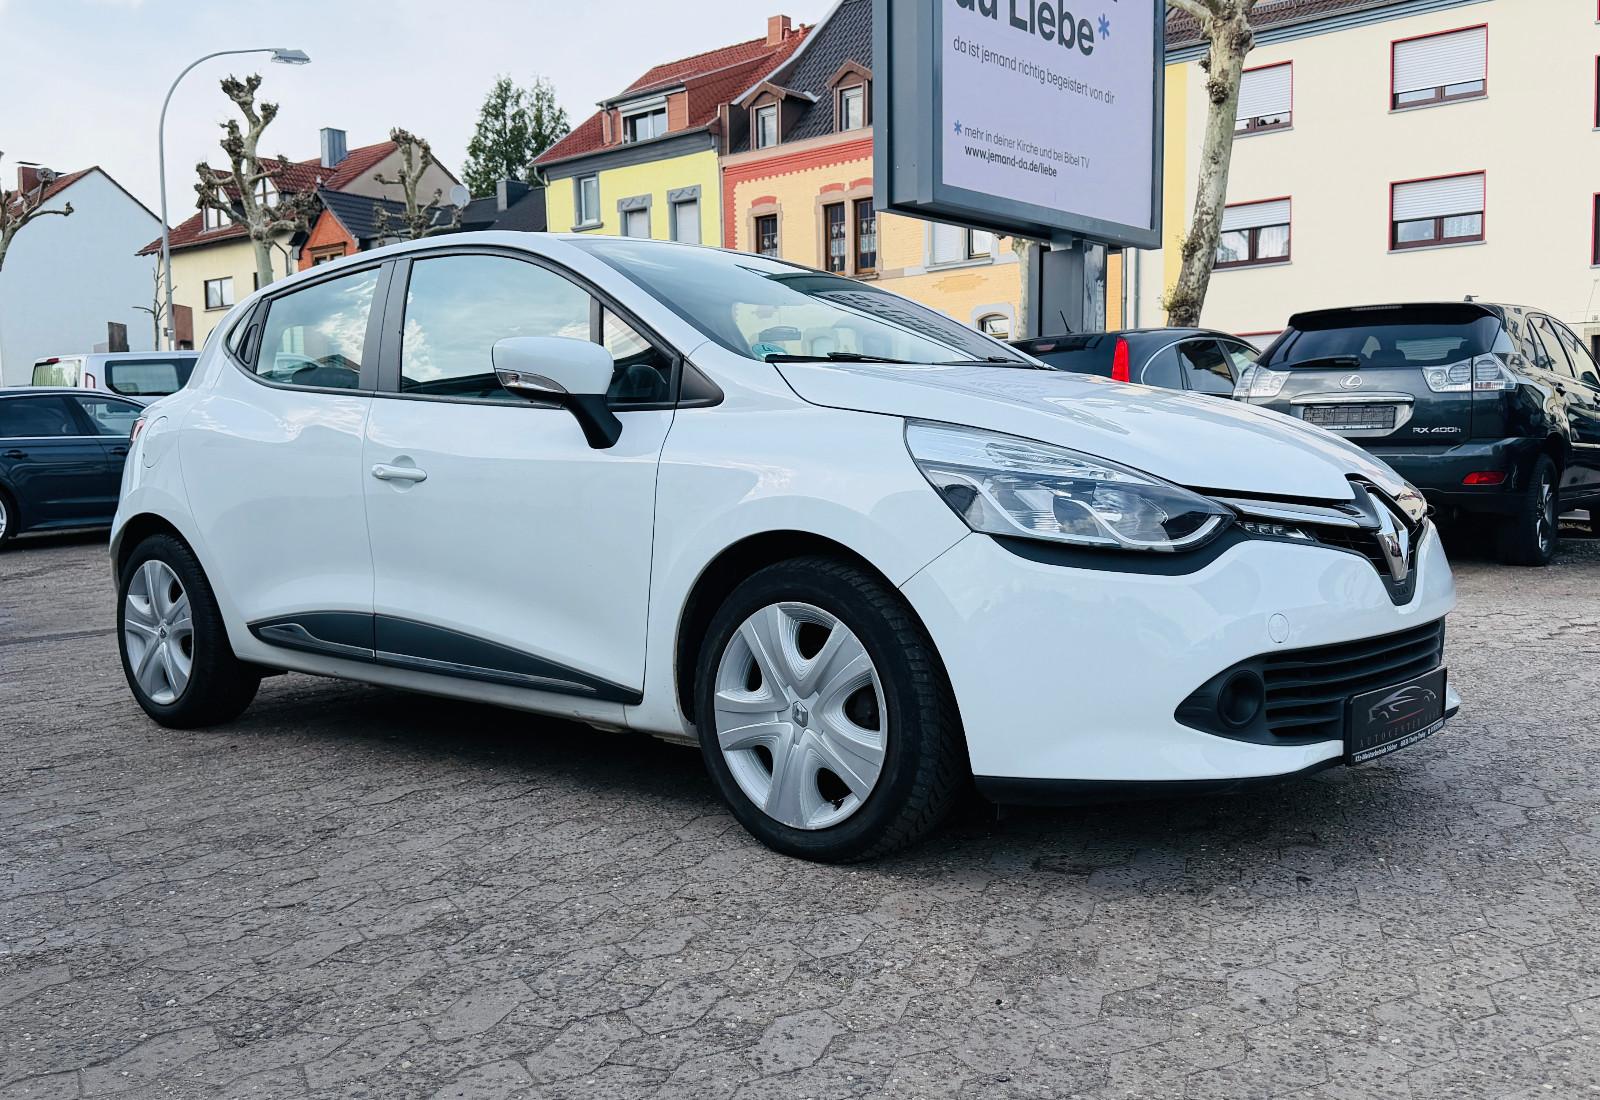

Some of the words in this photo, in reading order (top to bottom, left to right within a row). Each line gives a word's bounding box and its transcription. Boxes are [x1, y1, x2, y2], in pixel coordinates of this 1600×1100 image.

[953, 35, 967, 54] da
[968, 40, 980, 58] ist
[981, 45, 1017, 72] jemand
[1018, 60, 1046, 85] richtig
[1046, 68, 1089, 97] begeistert
[1089, 87, 1103, 102] von
[1104, 89, 1115, 105] dir
[964, 127, 984, 141] mehr
[985, 130, 993, 143] in
[993, 133, 1015, 149] deiner
[1016, 138, 1039, 156] Kirche
[1039, 147, 1052, 160] und
[1053, 149, 1063, 162] bei
[1064, 151, 1079, 167] Bibel
[1080, 155, 1091, 169] TV
[964, 145, 1057, 177] www.jemand-da.de/liebe
